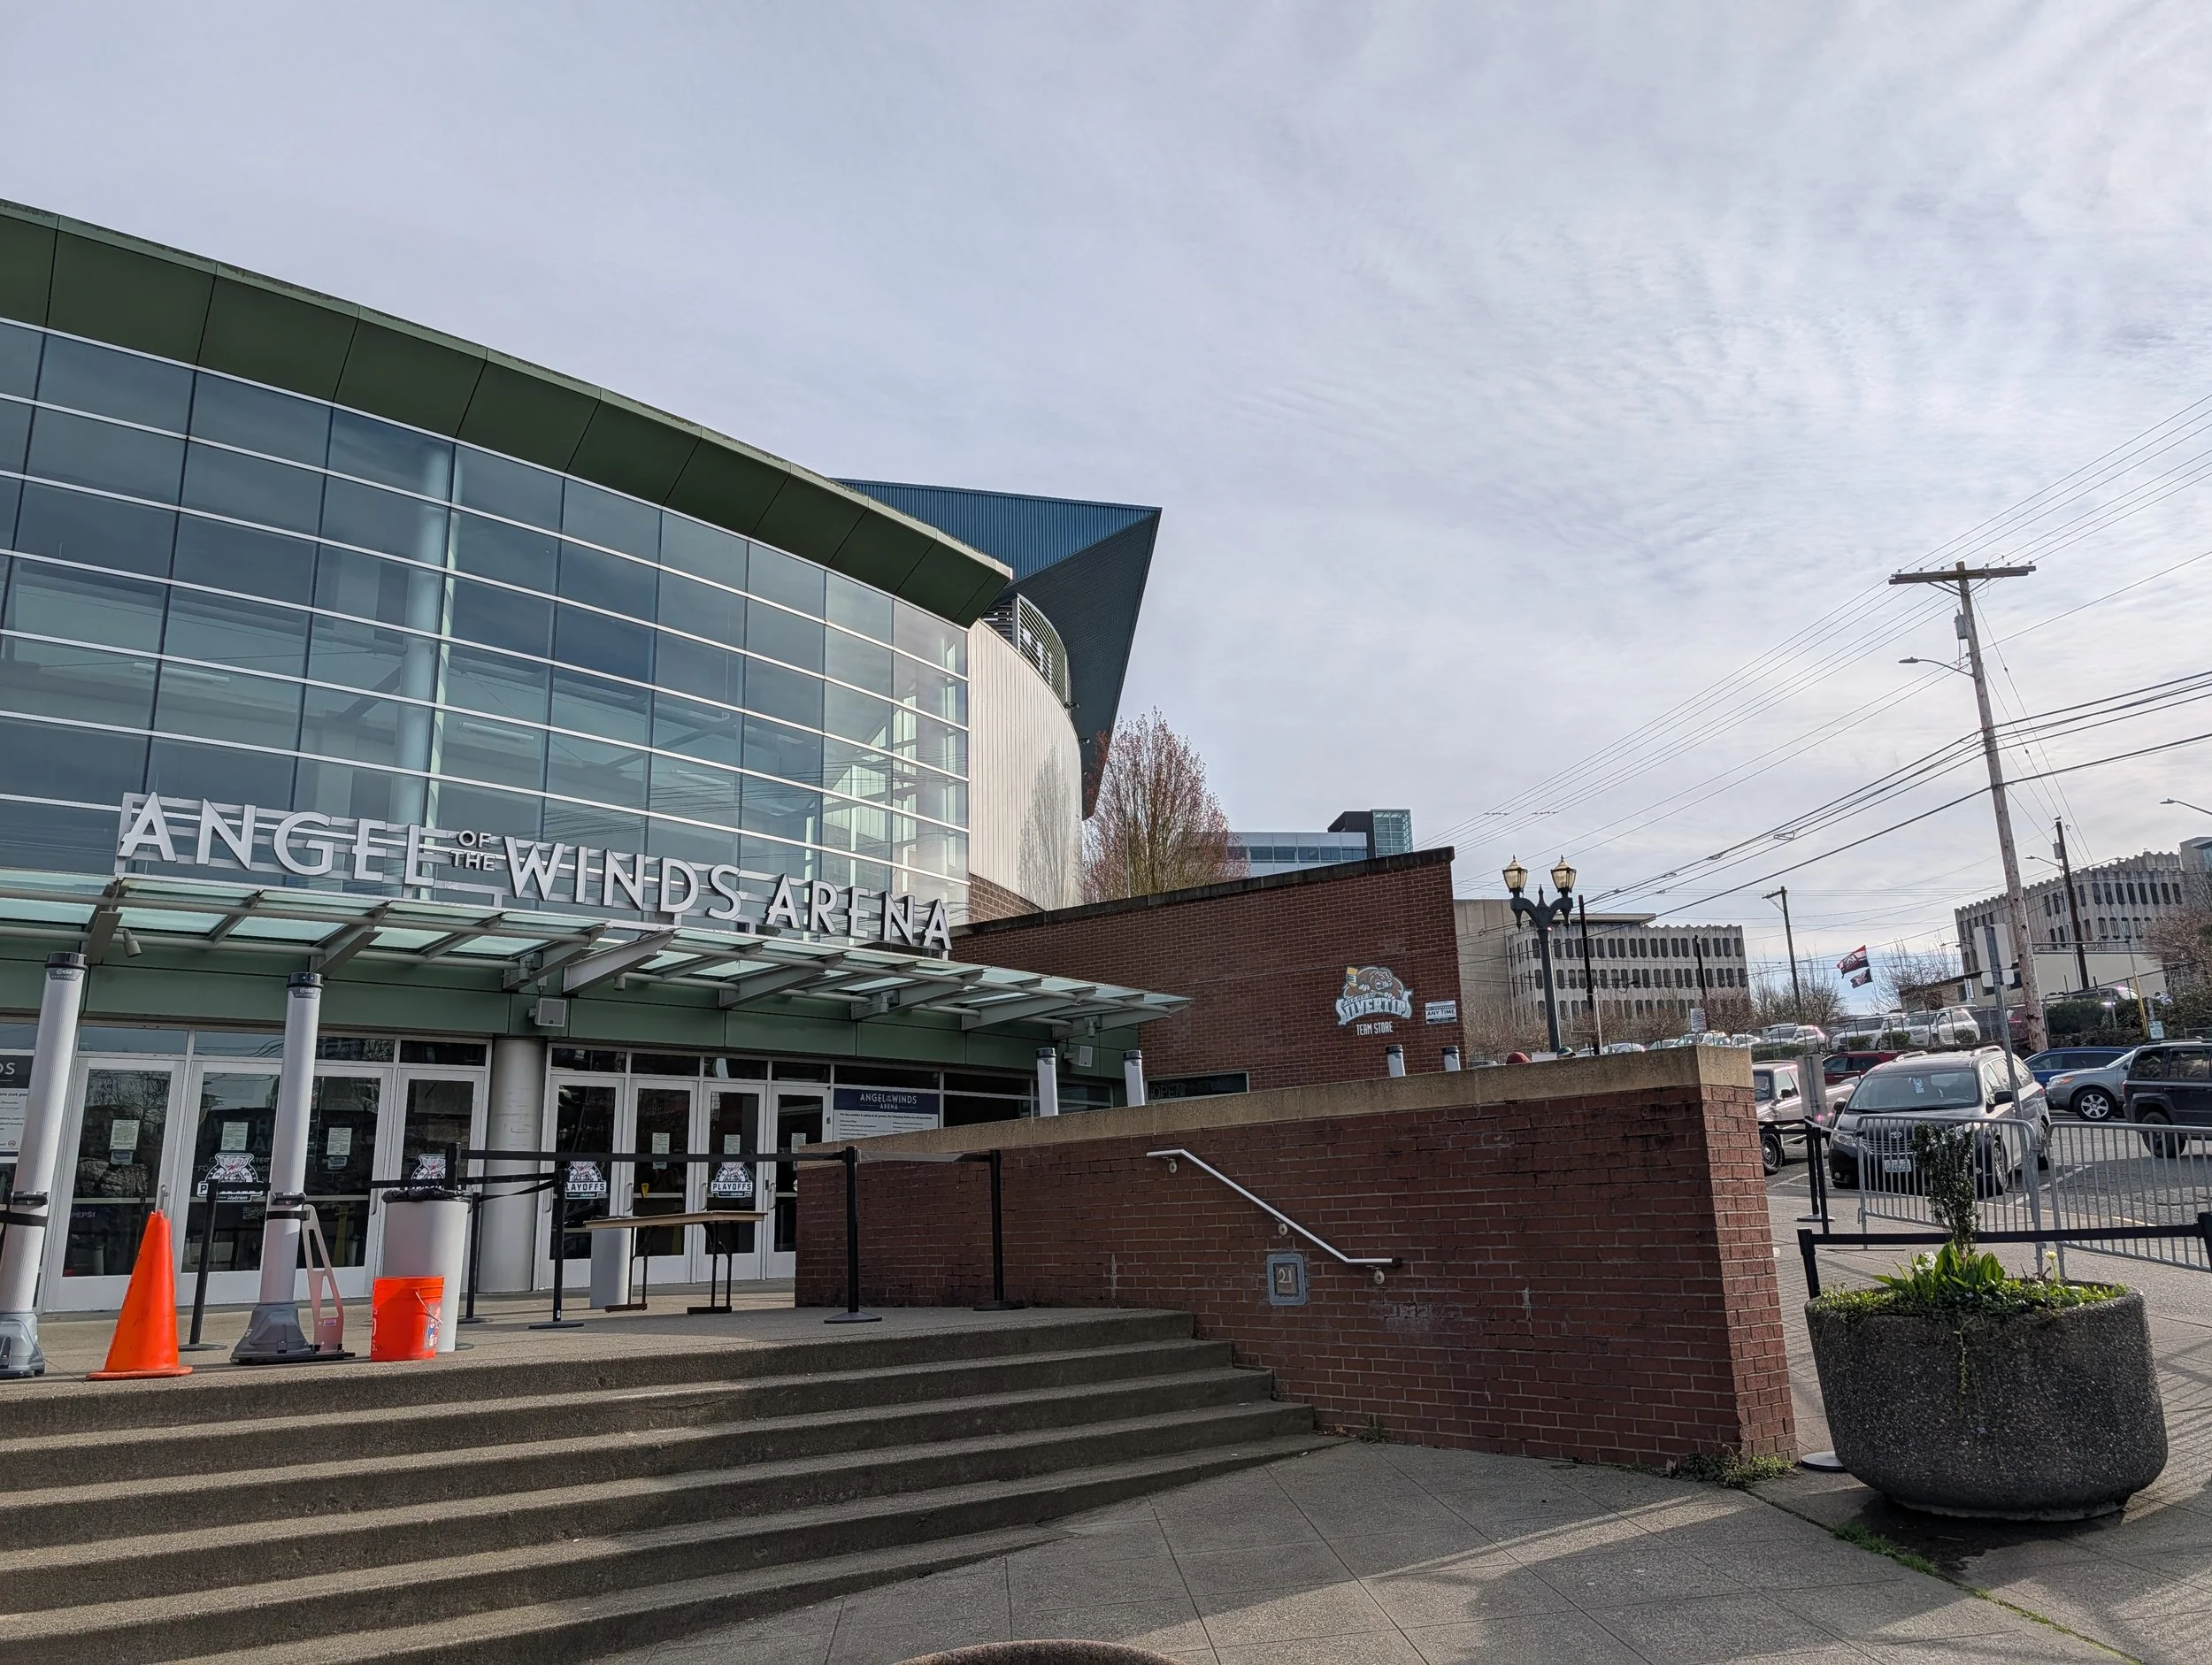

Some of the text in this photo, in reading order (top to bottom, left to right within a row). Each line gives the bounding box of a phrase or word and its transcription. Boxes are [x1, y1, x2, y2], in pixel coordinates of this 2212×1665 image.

[117, 791, 953, 950] ANGEL OF WINDS ARENA
[450, 849, 496, 871] THE
[1335, 990, 1413, 1025] SILVERTIPS
[1356, 1021, 1394, 1036] TEAM STORE
[859, 1093, 886, 1103] ANGEL
[891, 1094, 918, 1105] WINDS
